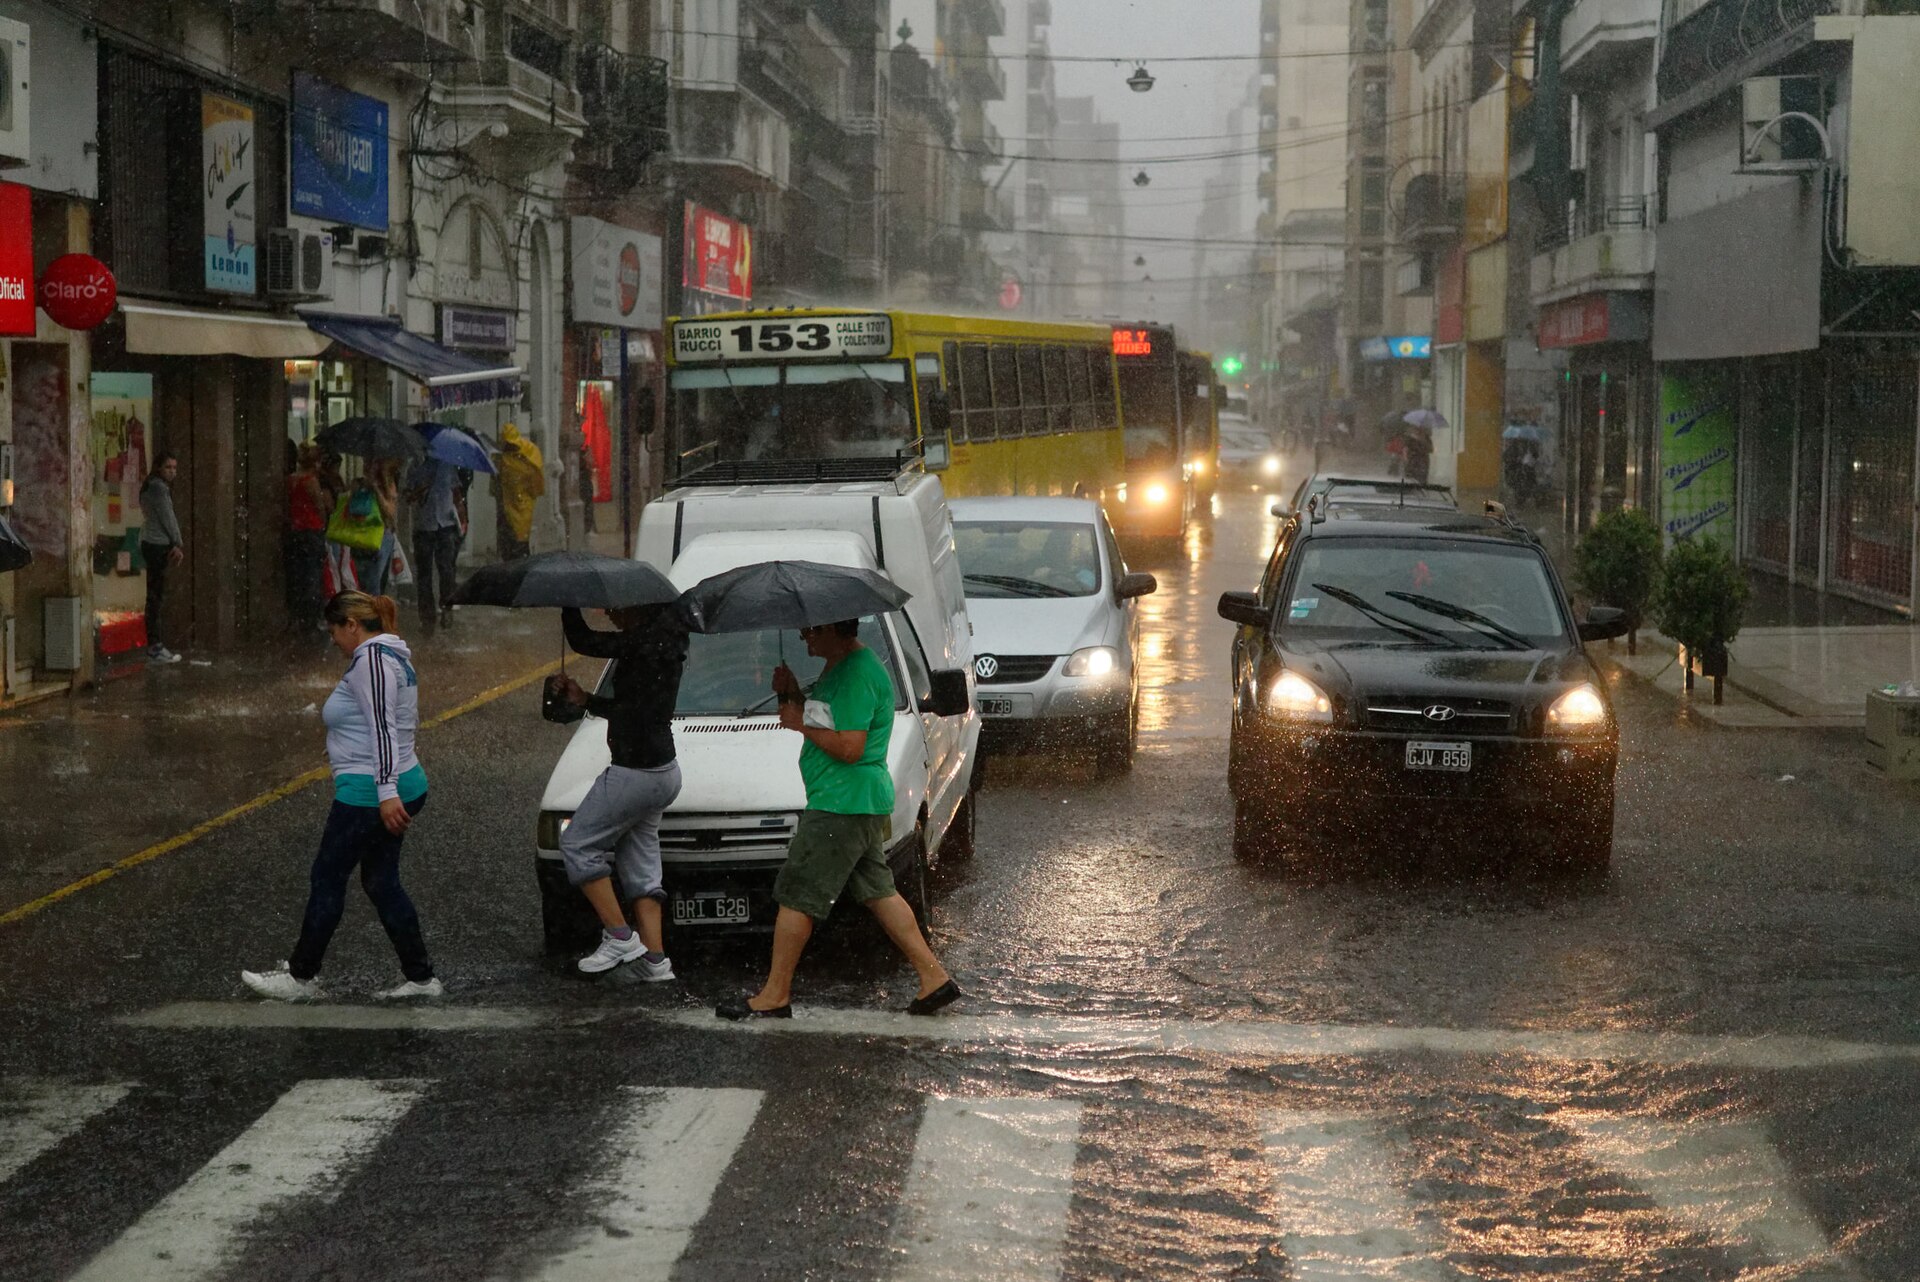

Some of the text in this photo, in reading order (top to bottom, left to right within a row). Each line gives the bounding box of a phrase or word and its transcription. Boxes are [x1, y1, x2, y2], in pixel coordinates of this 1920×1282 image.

[211, 253, 249, 276] Lemon
[44, 281, 97, 299] Claro
[678, 327, 722, 340] BARRIO
[836, 322, 863, 334] CALLE
[730, 323, 831, 352] 153
[837, 334, 886, 347] Y COLECTORA
[1136, 330, 1147, 342] Y
[678, 340, 722, 352] RUCCI
[990, 700, 1011, 713] 738
[1408, 749, 1434, 766] GJV
[676, 897, 746, 919] BRI 626
